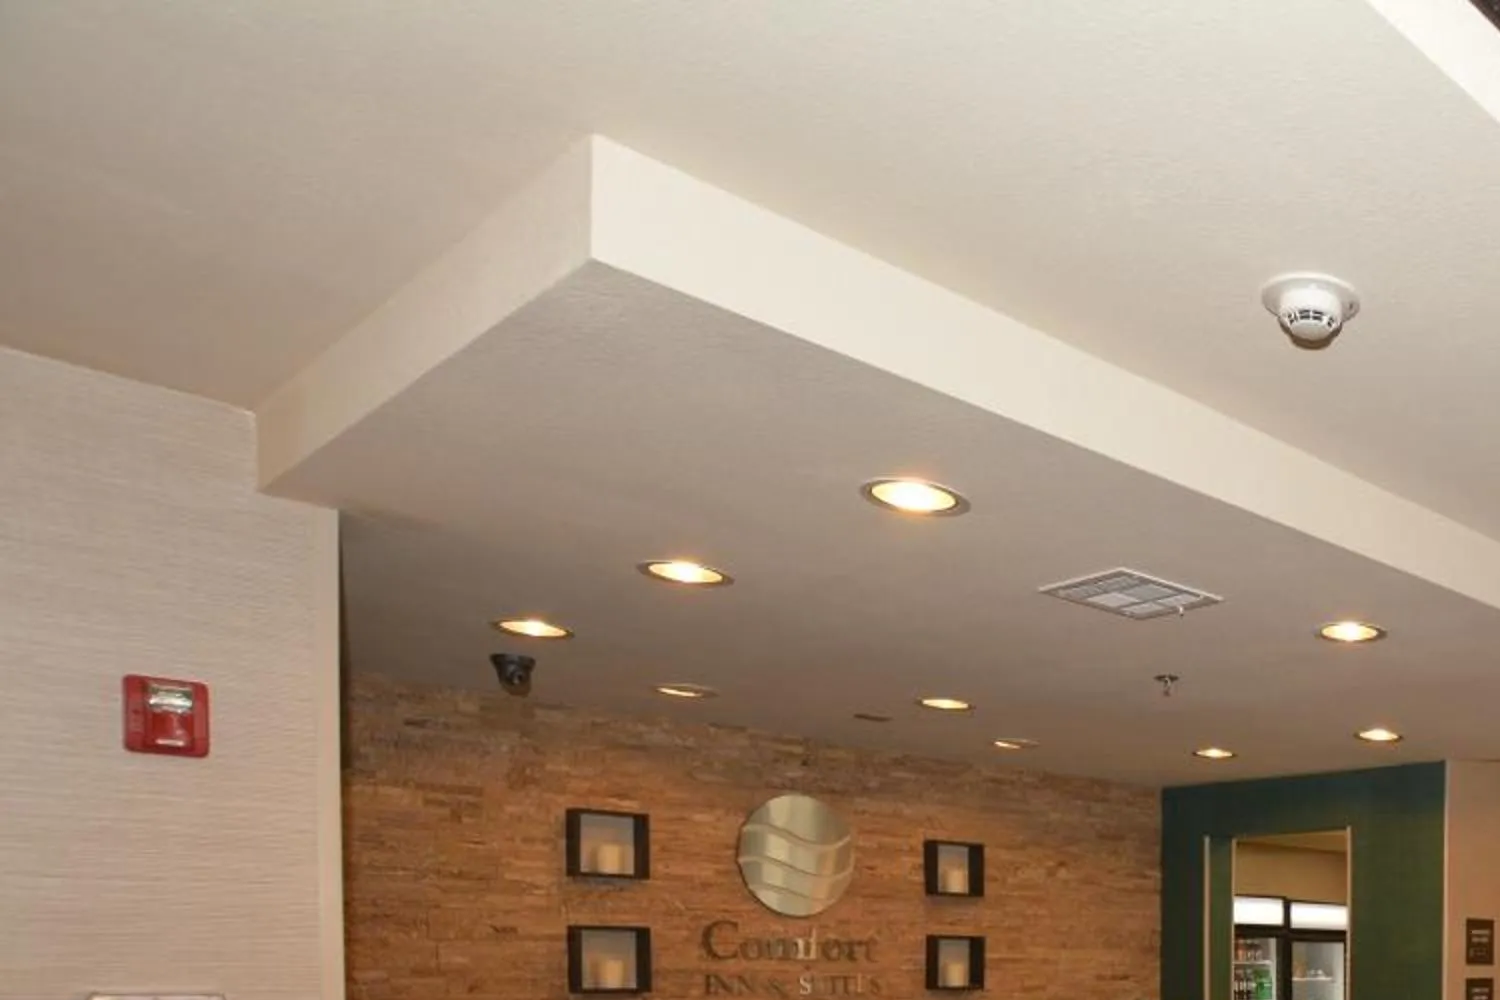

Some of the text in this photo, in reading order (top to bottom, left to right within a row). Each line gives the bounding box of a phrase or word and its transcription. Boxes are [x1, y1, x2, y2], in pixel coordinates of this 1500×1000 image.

[702, 920, 879, 962] Comfort
[704, 973, 755, 996] INN
[798, 973, 882, 997] SUITES
